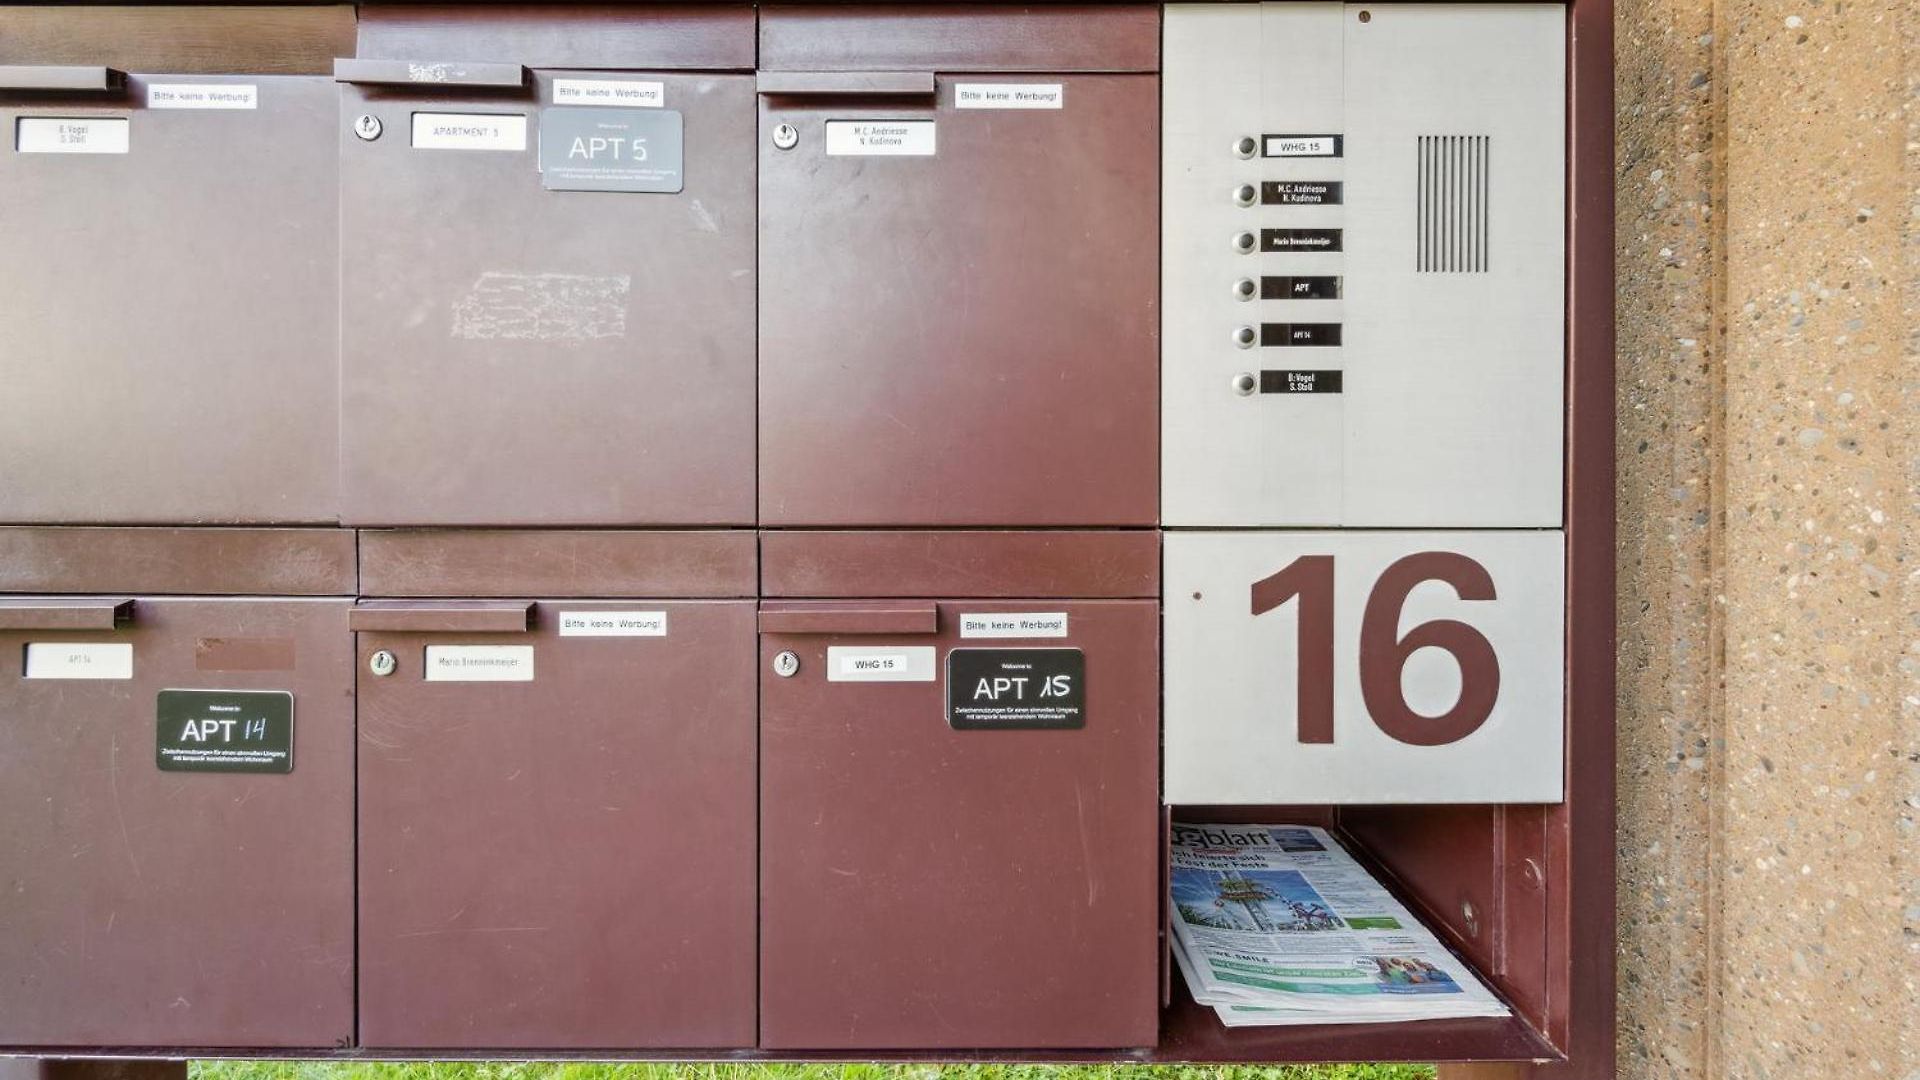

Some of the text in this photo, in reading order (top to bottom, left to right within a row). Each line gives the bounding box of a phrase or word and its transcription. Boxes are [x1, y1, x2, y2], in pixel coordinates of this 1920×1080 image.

[154, 91, 174, 101] Bitte
[179, 92, 203, 101] keine
[559, 87, 580, 96] Bitte
[586, 88, 610, 97] keine
[961, 91, 1057, 102] Bitte keine Werbung!
[433, 127, 489, 137] APARTMENT
[568, 137, 625, 159] APT
[632, 138, 647, 161] 5
[1281, 143, 1320, 151] WHG 15
[1294, 283, 1310, 292] APT
[1293, 331, 1303, 339] APT
[565, 620, 660, 629] Bitte keine Werbung!
[965, 620, 1062, 631] Bitte keine Werbung!
[1250, 551, 1501, 747] 16
[855, 660, 894, 669] WHG 15
[973, 678, 1028, 699] APT
[181, 720, 237, 742] APT
[245, 718, 266, 740] 14
